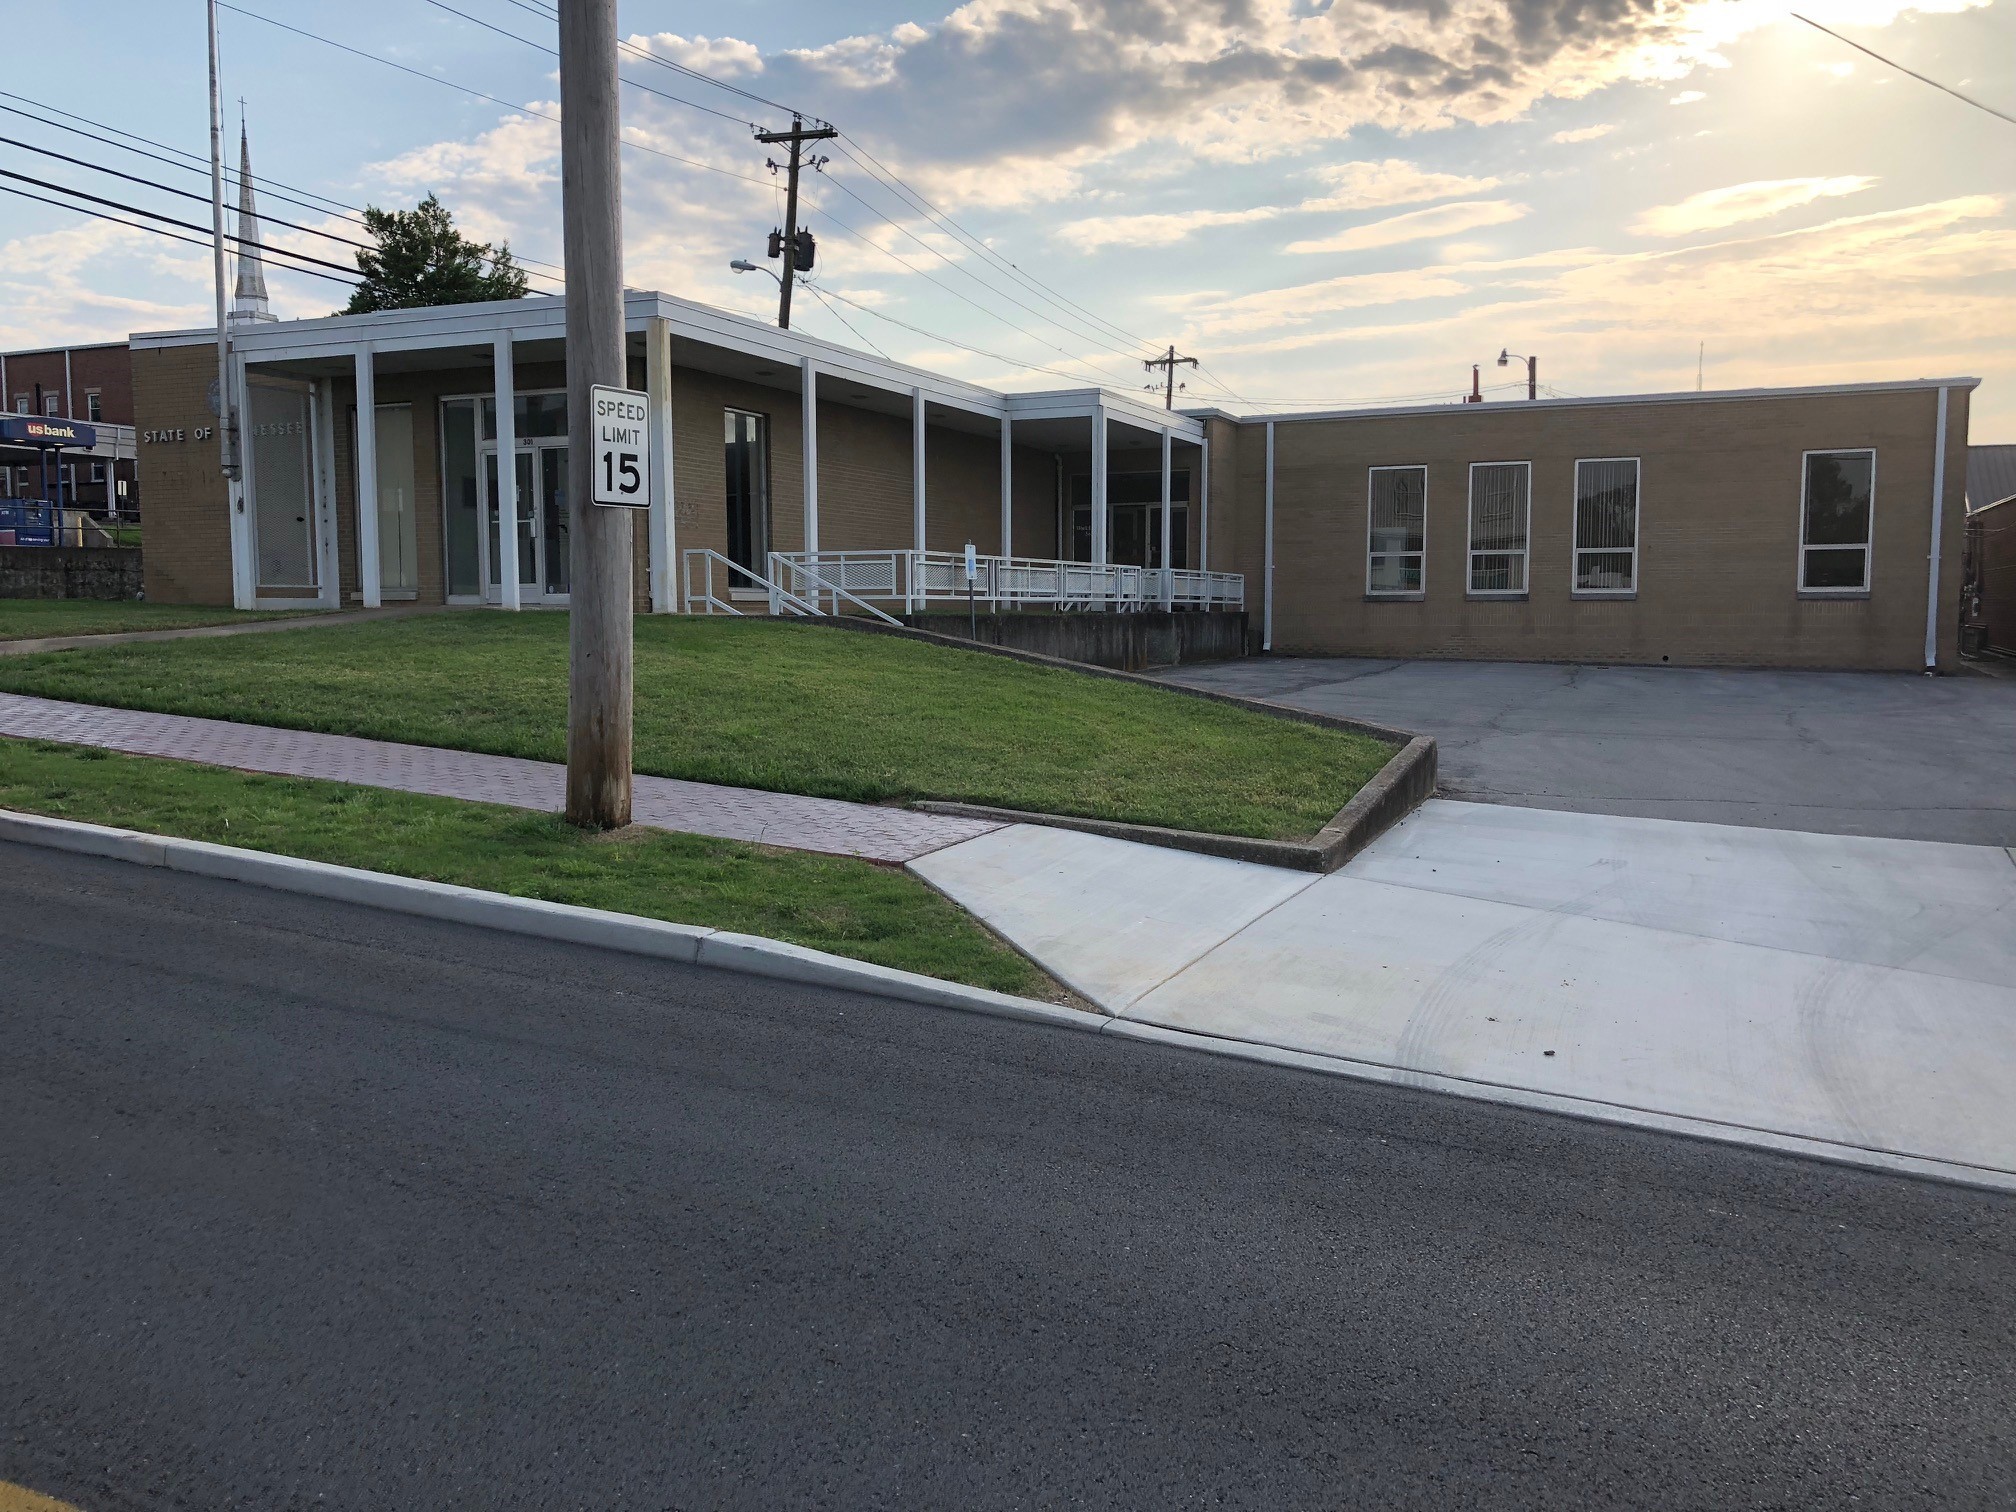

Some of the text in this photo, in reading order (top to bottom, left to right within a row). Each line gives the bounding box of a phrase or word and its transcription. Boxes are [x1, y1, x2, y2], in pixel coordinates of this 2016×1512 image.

[597, 399, 646, 422] SPEED
[143, 429, 185, 443] STATE
[194, 426, 213, 440] OF
[602, 425, 640, 446] LIMIT
[603, 451, 641, 494] 15
